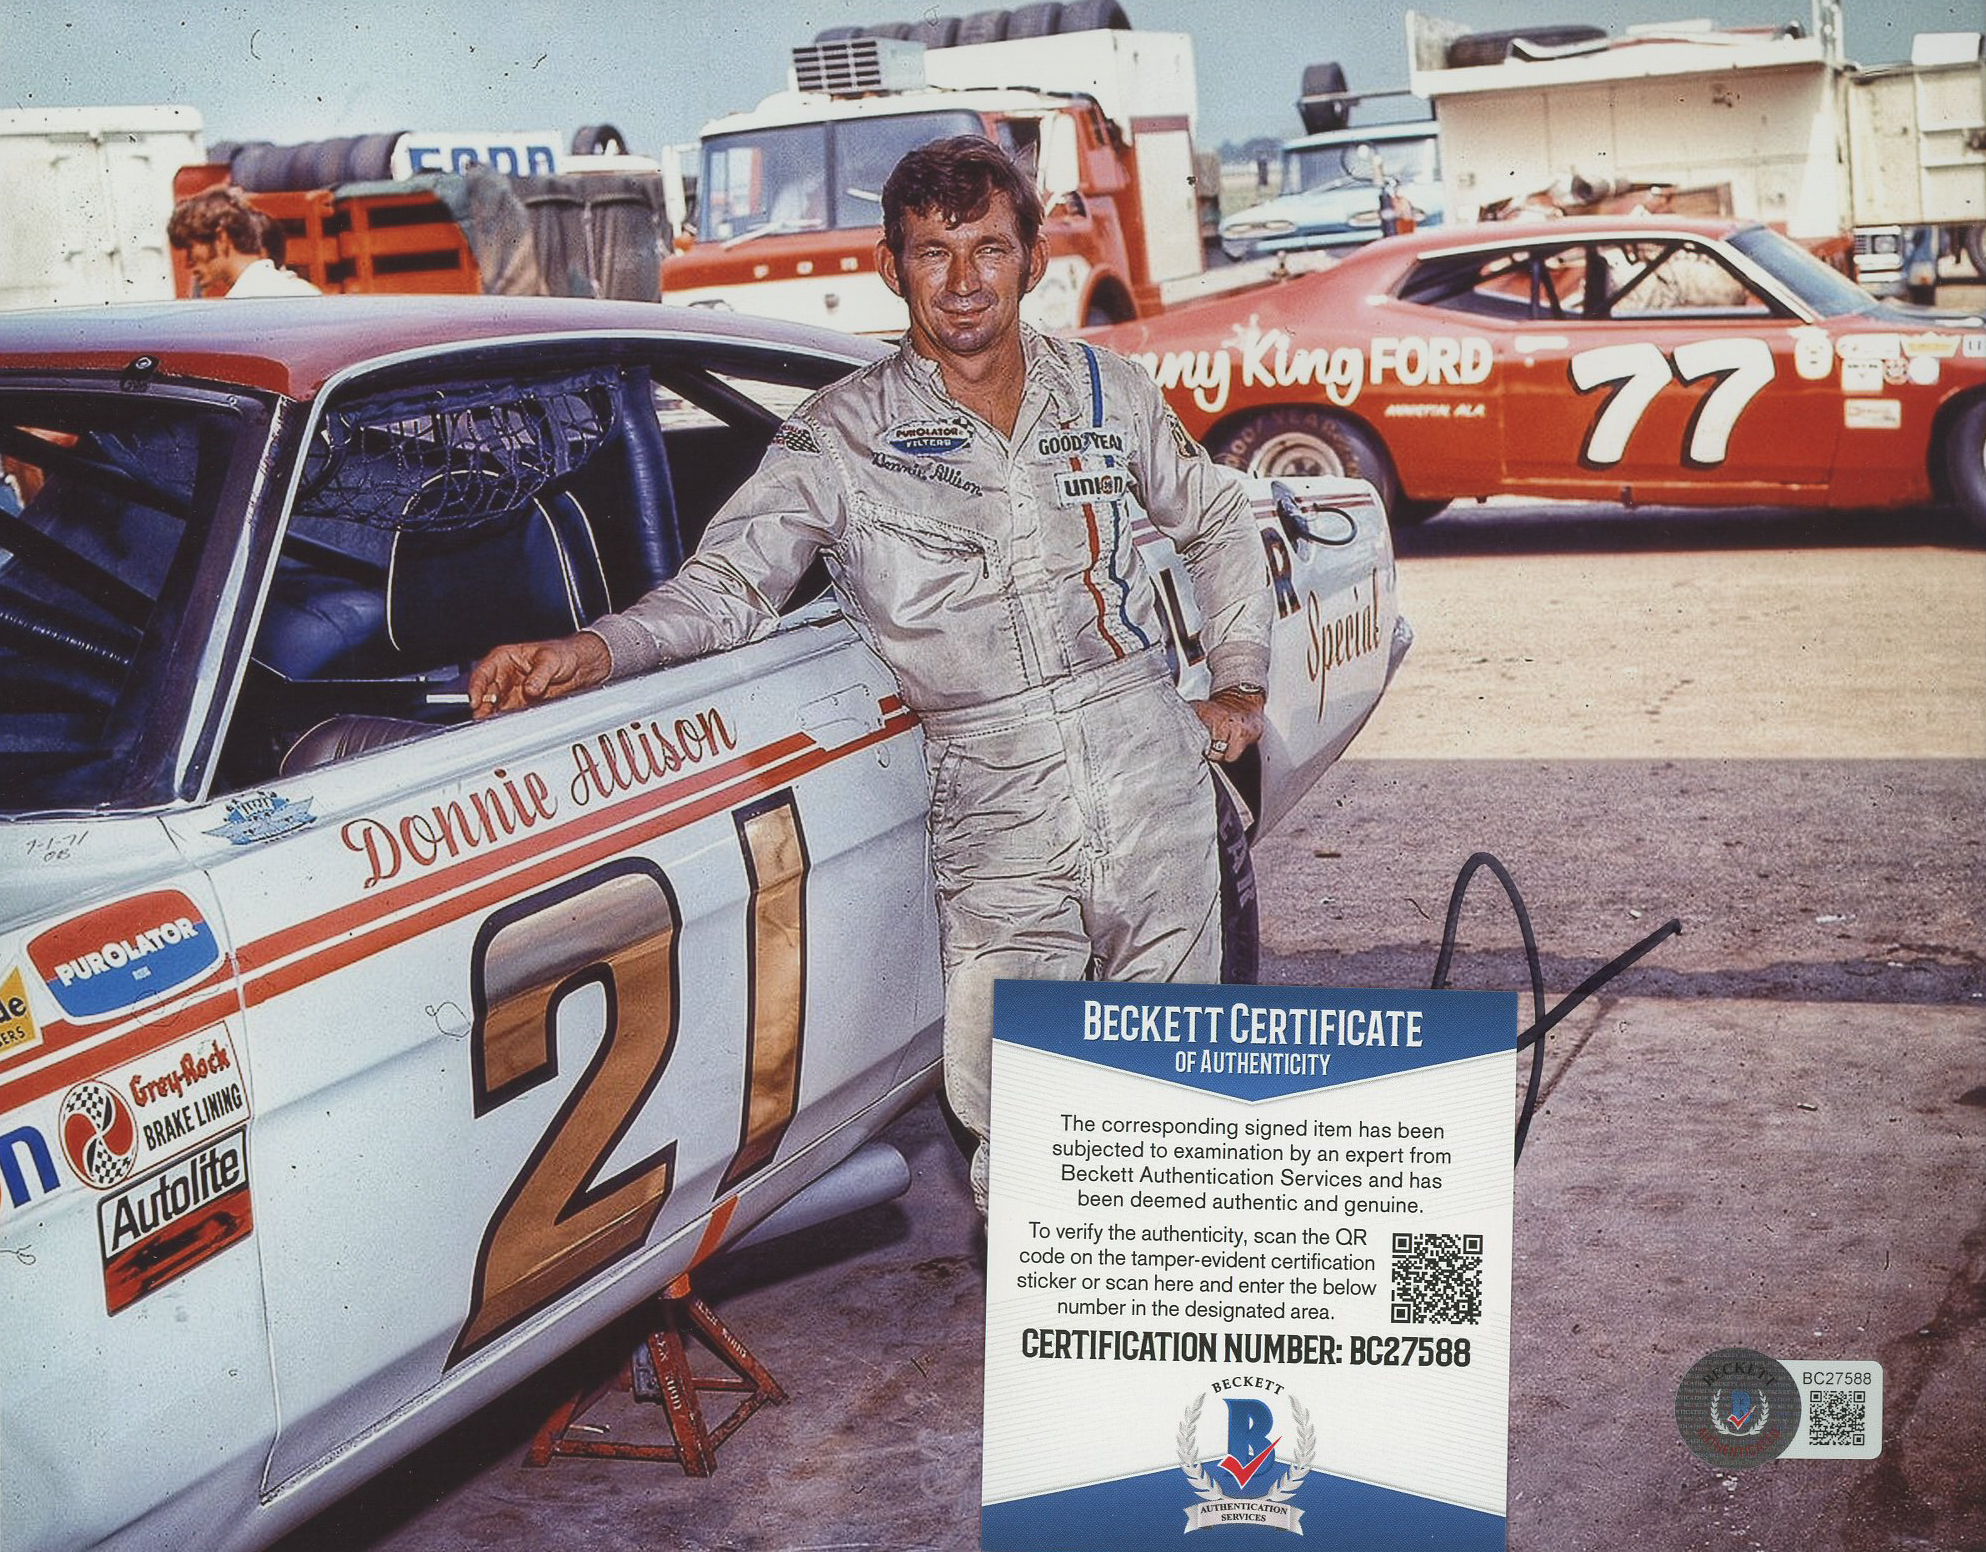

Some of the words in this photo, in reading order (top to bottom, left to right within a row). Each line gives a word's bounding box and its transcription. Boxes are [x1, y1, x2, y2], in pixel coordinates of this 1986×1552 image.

[1243, 328, 1364, 406] King
[1370, 336, 1493, 387] FORD
[1567, 338, 1776, 470] 77
[895, 427, 959, 438] PUROLATOR
[930, 463, 983, 497] Allison
[1307, 567, 1379, 722] Special
[341, 767, 559, 889] Donnie
[570, 706, 738, 806] Allison
[53, 917, 199, 988] PUROLATOR
[0, 1025, 25, 1047] ERS
[1083, 1000, 1224, 1044] BECKETT
[1230, 1002, 1424, 1048] CERTIFICATE
[128, 1039, 231, 1108] Grey-Rock
[1175, 1051, 1197, 1073] OF
[1200, 1049, 1331, 1076] AUTHENTICITY
[442, 786, 812, 1374] 21
[143, 1105, 195, 1151] BRAKE
[193, 1082, 244, 1126] LINING
[1061, 1115, 1095, 1131] The
[1102, 1118, 1237, 1139] corresponding
[1245, 1120, 1307, 1140] signed
[1314, 1121, 1351, 1138] item
[1360, 1121, 1391, 1138] has
[1399, 1122, 1443, 1138] been
[1053, 1140, 1143, 1161] subjected
[1150, 1143, 1167, 1158] to
[1174, 1144, 1282, 1160] examination
[1291, 1144, 1311, 1165] by
[1318, 1149, 1338, 1162] an
[1346, 1148, 1403, 1168] expert
[1410, 1147, 1451, 1163] from
[1062, 1164, 1133, 1182] Beckett
[1140, 1166, 1273, 1185] Authentication
[1281, 1169, 1361, 1187] Services
[1369, 1171, 1402, 1188] and
[1410, 1172, 1442, 1188] has
[111, 1147, 239, 1252] Autolite
[1078, 1189, 1123, 1206] been
[1131, 1191, 1205, 1208] deemed
[1213, 1193, 1297, 1210] authentic
[1304, 1195, 1337, 1211] and
[1345, 1198, 1423, 1217] genuine.
[1029, 1222, 1050, 1239] To
[1056, 1223, 1105, 1244] verify
[1109, 1224, 1135, 1241] the
[1142, 1225, 1247, 1248] authenticity,
[1254, 1231, 1296, 1244] scan
[1302, 1228, 1329, 1244] the
[1336, 1228, 1367, 1245] QR
[1019, 1247, 1064, 1264] code
[1071, 1252, 1092, 1265] on
[1098, 1249, 1125, 1265] the
[1131, 1250, 1265, 1271] tamper-evident
[1271, 1253, 1375, 1271] certification
[1017, 1272, 1076, 1288] sticker
[1082, 1277, 1100, 1289] or
[1106, 1277, 1148, 1290] scan
[1155, 1275, 1193, 1291] here
[1200, 1276, 1232, 1292] and
[1239, 1278, 1284, 1293] enter
[1290, 1278, 1316, 1294] the
[1324, 1278, 1377, 1295] below
[1058, 1298, 1126, 1315] number
[1132, 1299, 1146, 1315] in
[1152, 1300, 1179, 1316] the
[1186, 1301, 1285, 1322] designated
[1291, 1306, 1335, 1320] area.
[1022, 1328, 1217, 1362] CERTIFICATION
[1224, 1333, 1343, 1365] NUMBER:
[1350, 1336, 1471, 1368] BC27588
[1211, 1376, 1285, 1396] BECKETT
[1802, 1371, 1872, 1386] BC27588
[1200, 1502, 1289, 1515] AUTHENTICATION
[1221, 1513, 1267, 1522] SERVICES
